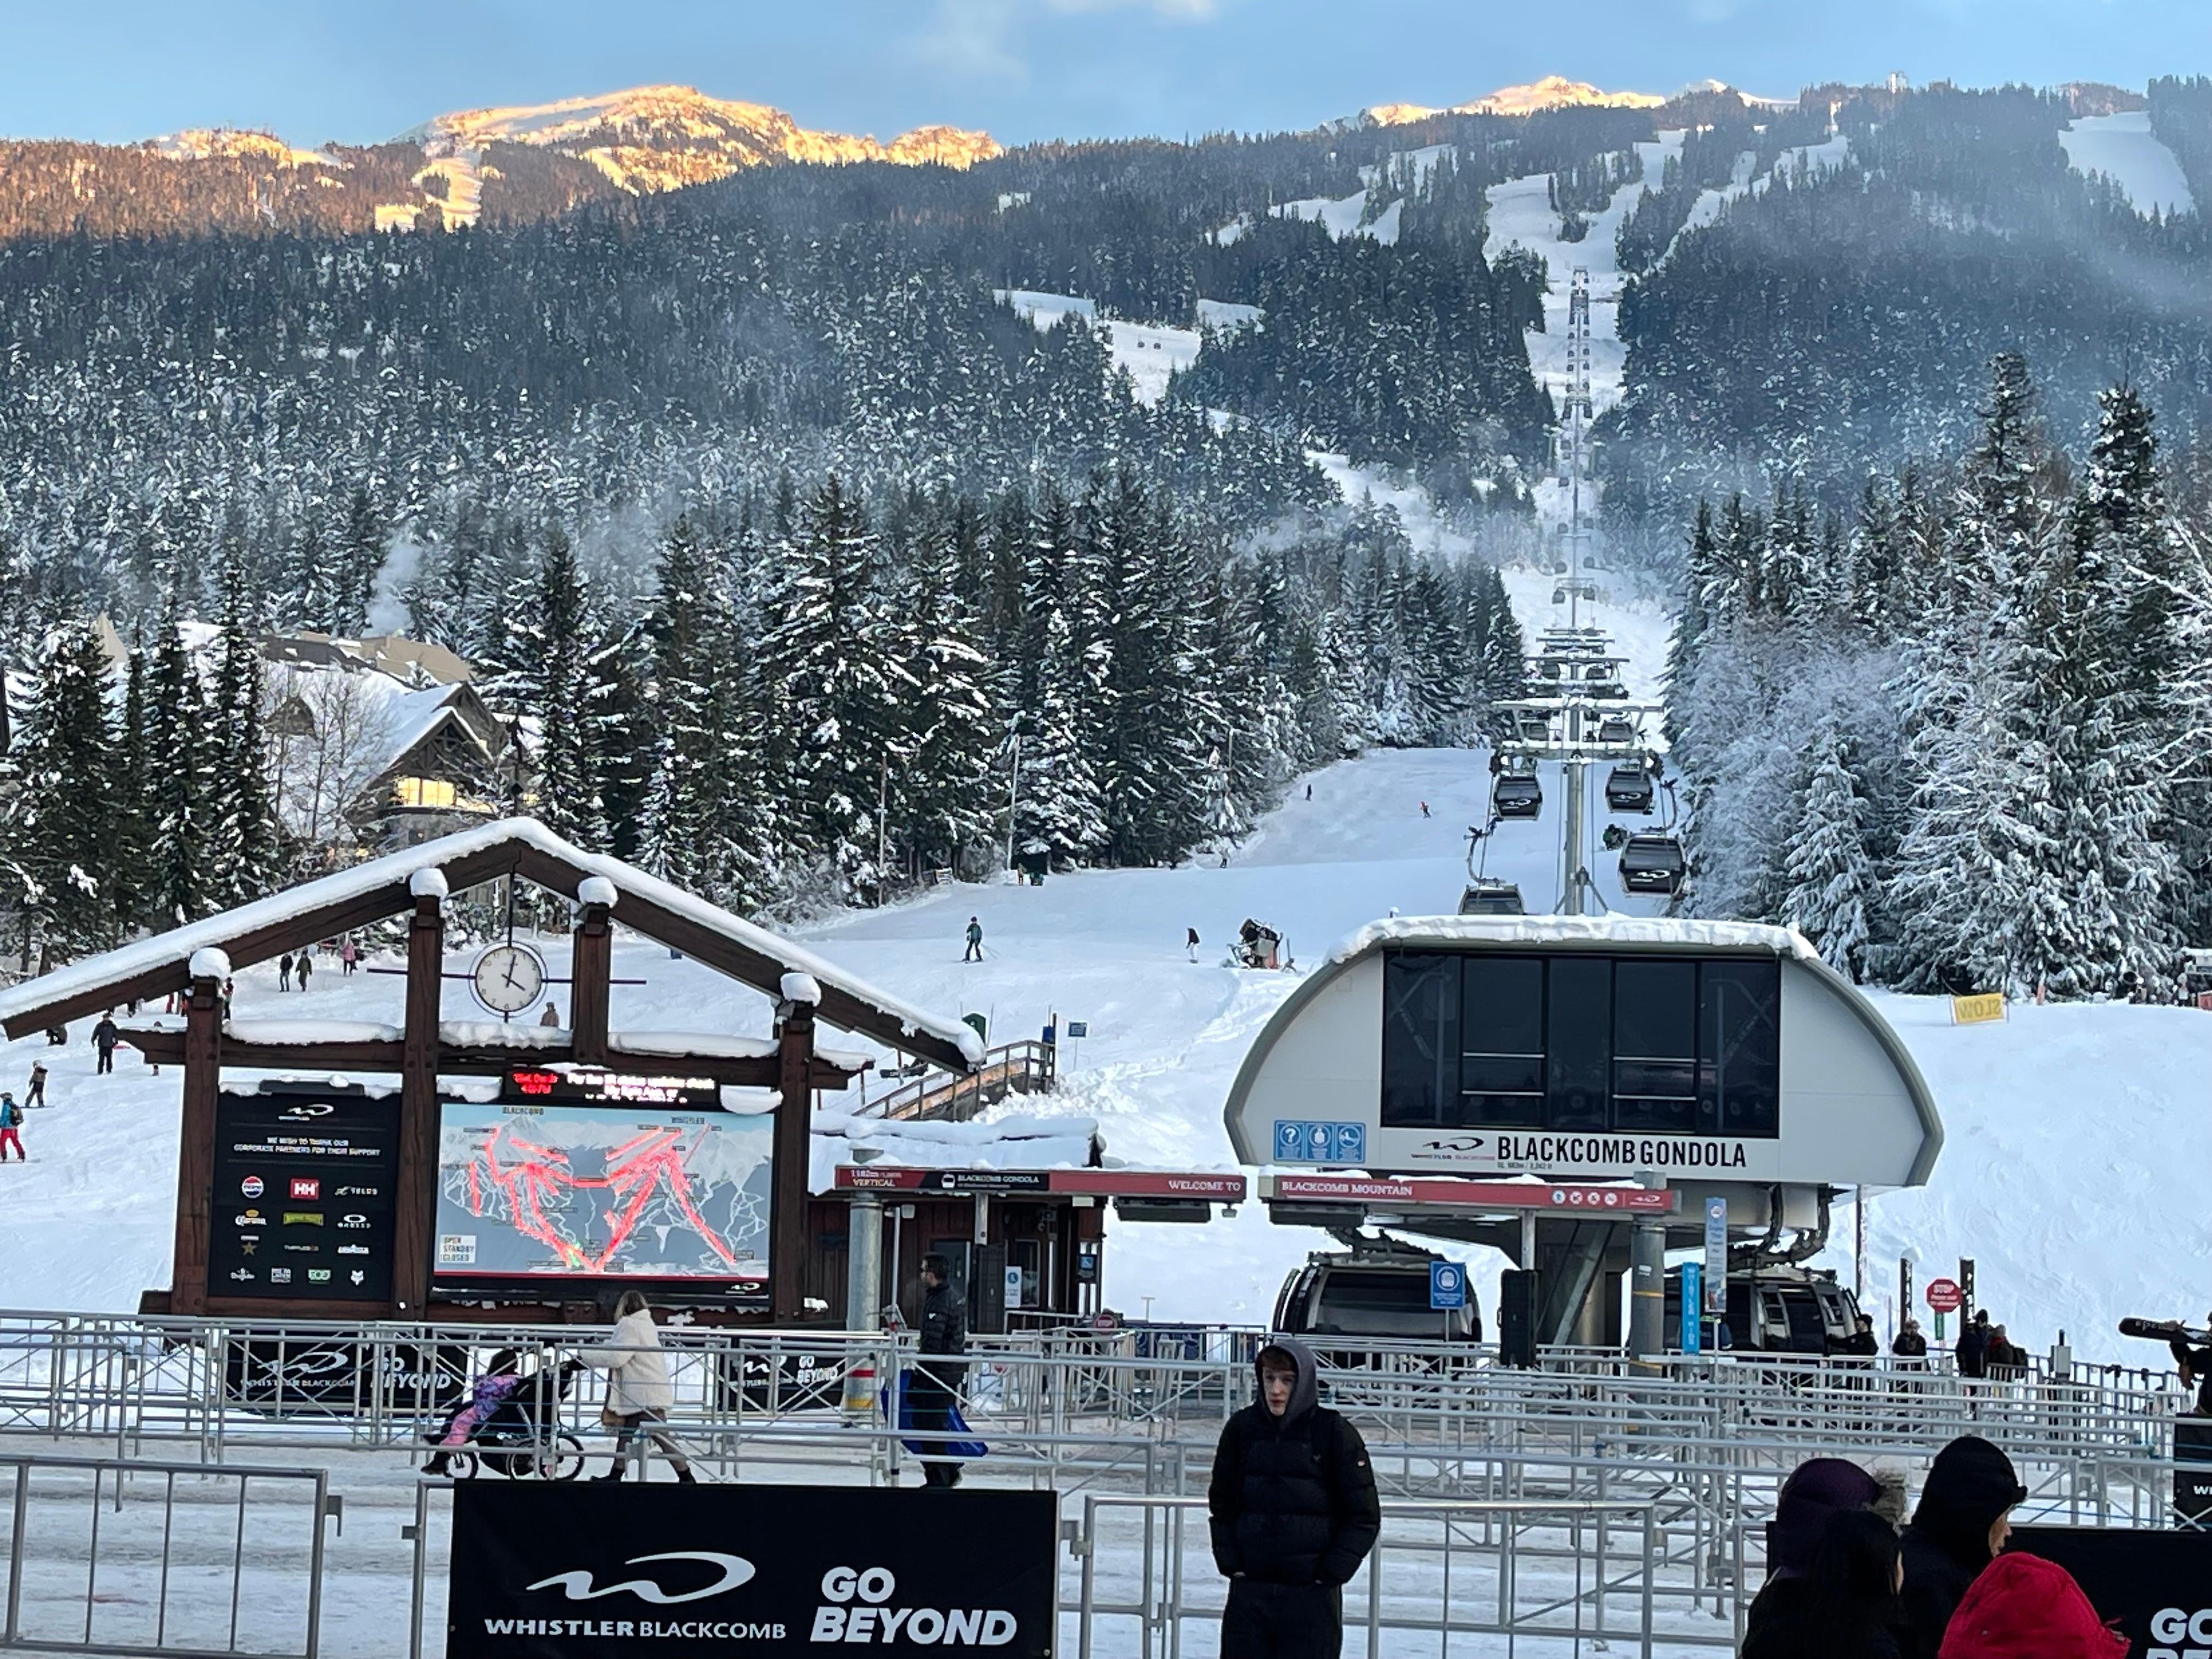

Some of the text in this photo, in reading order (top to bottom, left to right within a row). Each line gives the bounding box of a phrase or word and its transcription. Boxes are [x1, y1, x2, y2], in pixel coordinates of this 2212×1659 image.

[503, 1107, 544, 1115] BLACKCOMB
[1498, 1136, 1747, 1167] BLACKCOMB GONDOLA
[853, 1178, 895, 1187] VERTICAL
[957, 1174, 1001, 1182] BLACKCOMB
[1169, 1180, 1242, 1192] WELCOME TO
[1282, 1181, 1413, 1196] BLACKCOMB MOUNTAIN
[821, 1566, 895, 1604] GO
[484, 1619, 787, 1639] WHISTLER BLACKCOMB
[810, 1606, 1017, 1645] BEYOND
[2150, 1607, 2212, 1646] GO
